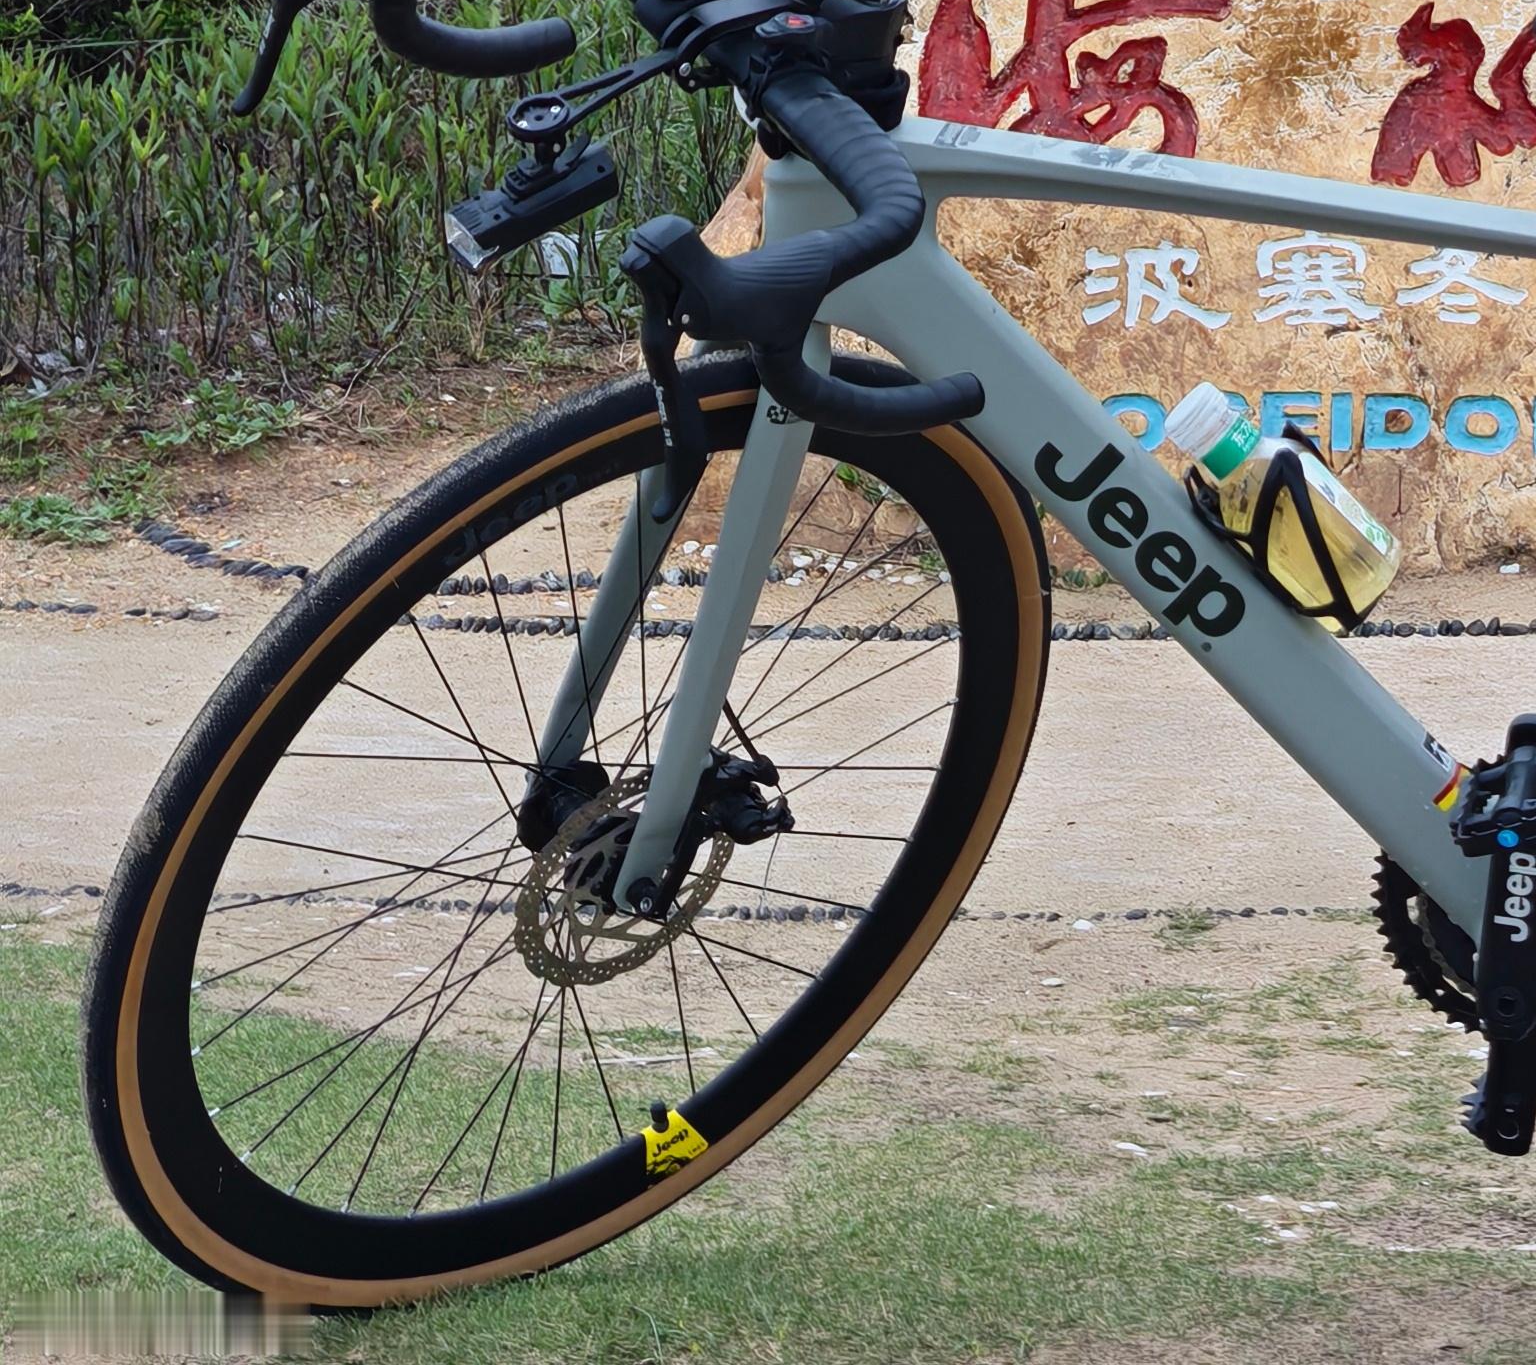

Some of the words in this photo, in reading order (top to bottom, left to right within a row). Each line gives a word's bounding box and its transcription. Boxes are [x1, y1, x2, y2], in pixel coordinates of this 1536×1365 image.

[1082, 231, 1528, 330] 波塞冬
[1034, 442, 1246, 638] Jeep
[652, 1129, 688, 1158] Jeep
